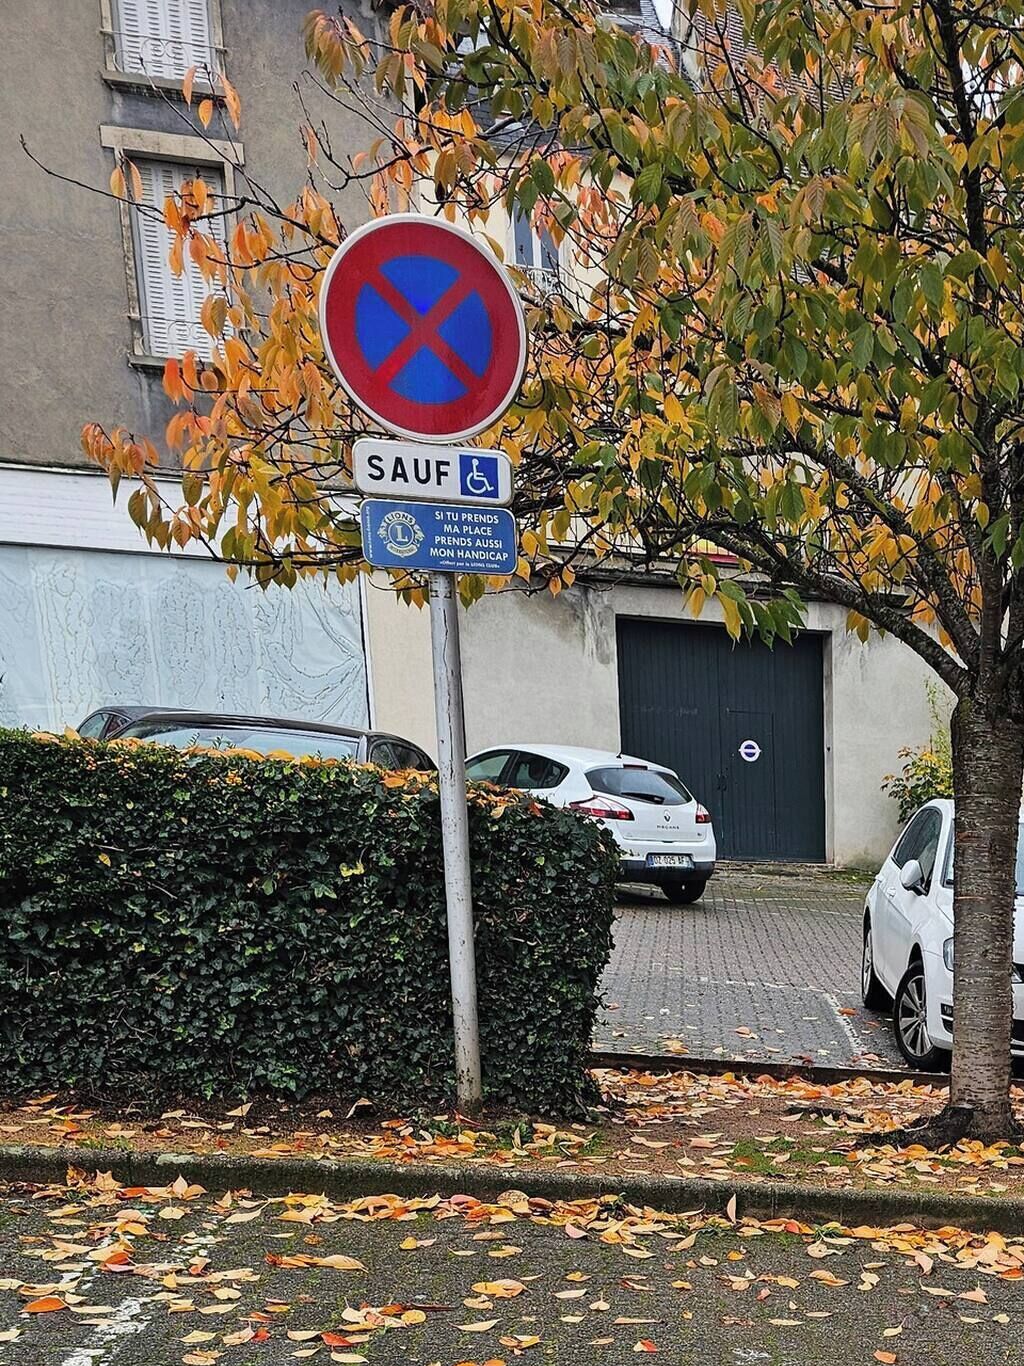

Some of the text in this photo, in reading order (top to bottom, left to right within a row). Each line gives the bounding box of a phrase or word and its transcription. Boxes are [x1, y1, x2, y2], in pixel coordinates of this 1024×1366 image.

[367, 454, 451, 486] SAUF
[387, 512, 413, 524] LIONS
[434, 511, 499, 524] SI TU PRENDS
[444, 524, 492, 536] MA PLACE
[434, 536, 503, 549] PRENDS AUSSI
[430, 547, 455, 558] MON
[457, 550, 509, 561] HANDICAP
